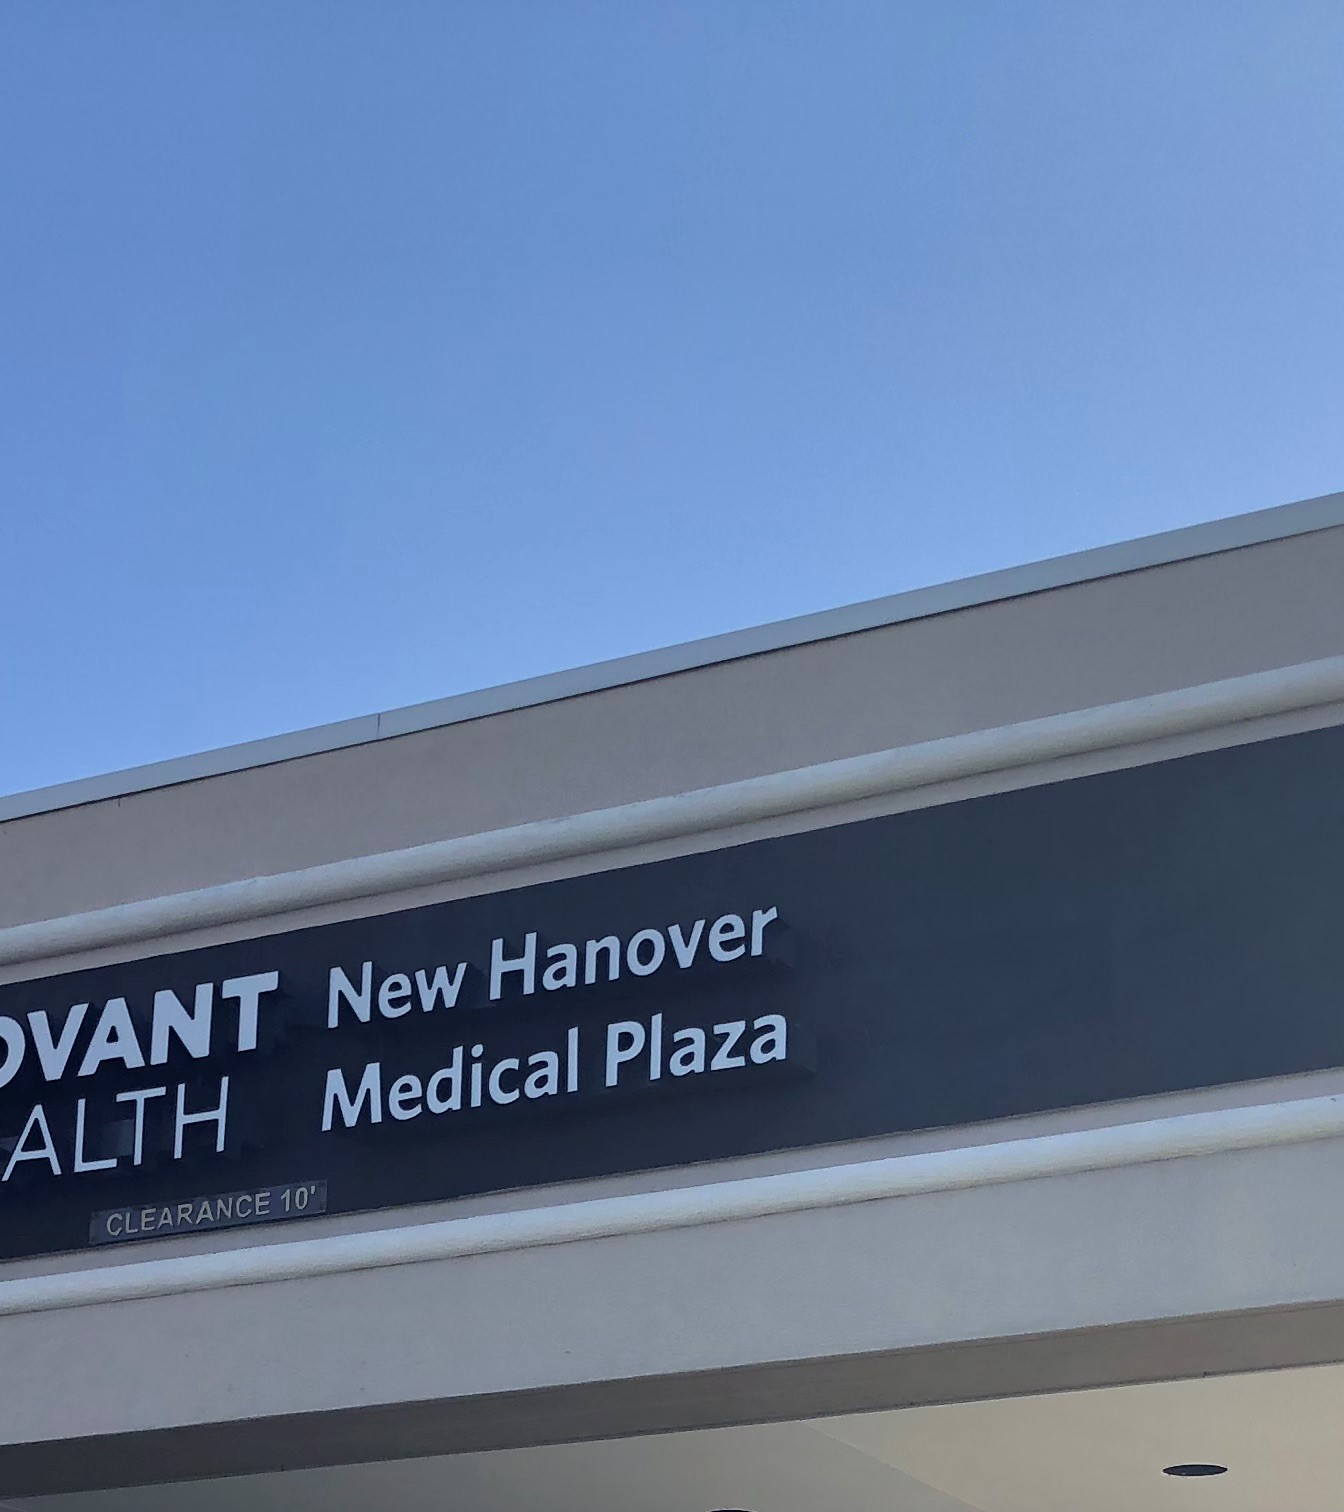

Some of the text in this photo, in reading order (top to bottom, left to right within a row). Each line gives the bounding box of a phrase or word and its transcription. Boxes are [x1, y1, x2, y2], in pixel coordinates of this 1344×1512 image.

[327, 906, 778, 1028] New Hanover
[321, 1013, 787, 1132] Medical Plaza
[106, 1185, 316, 1236] CLEARANCE 10'
